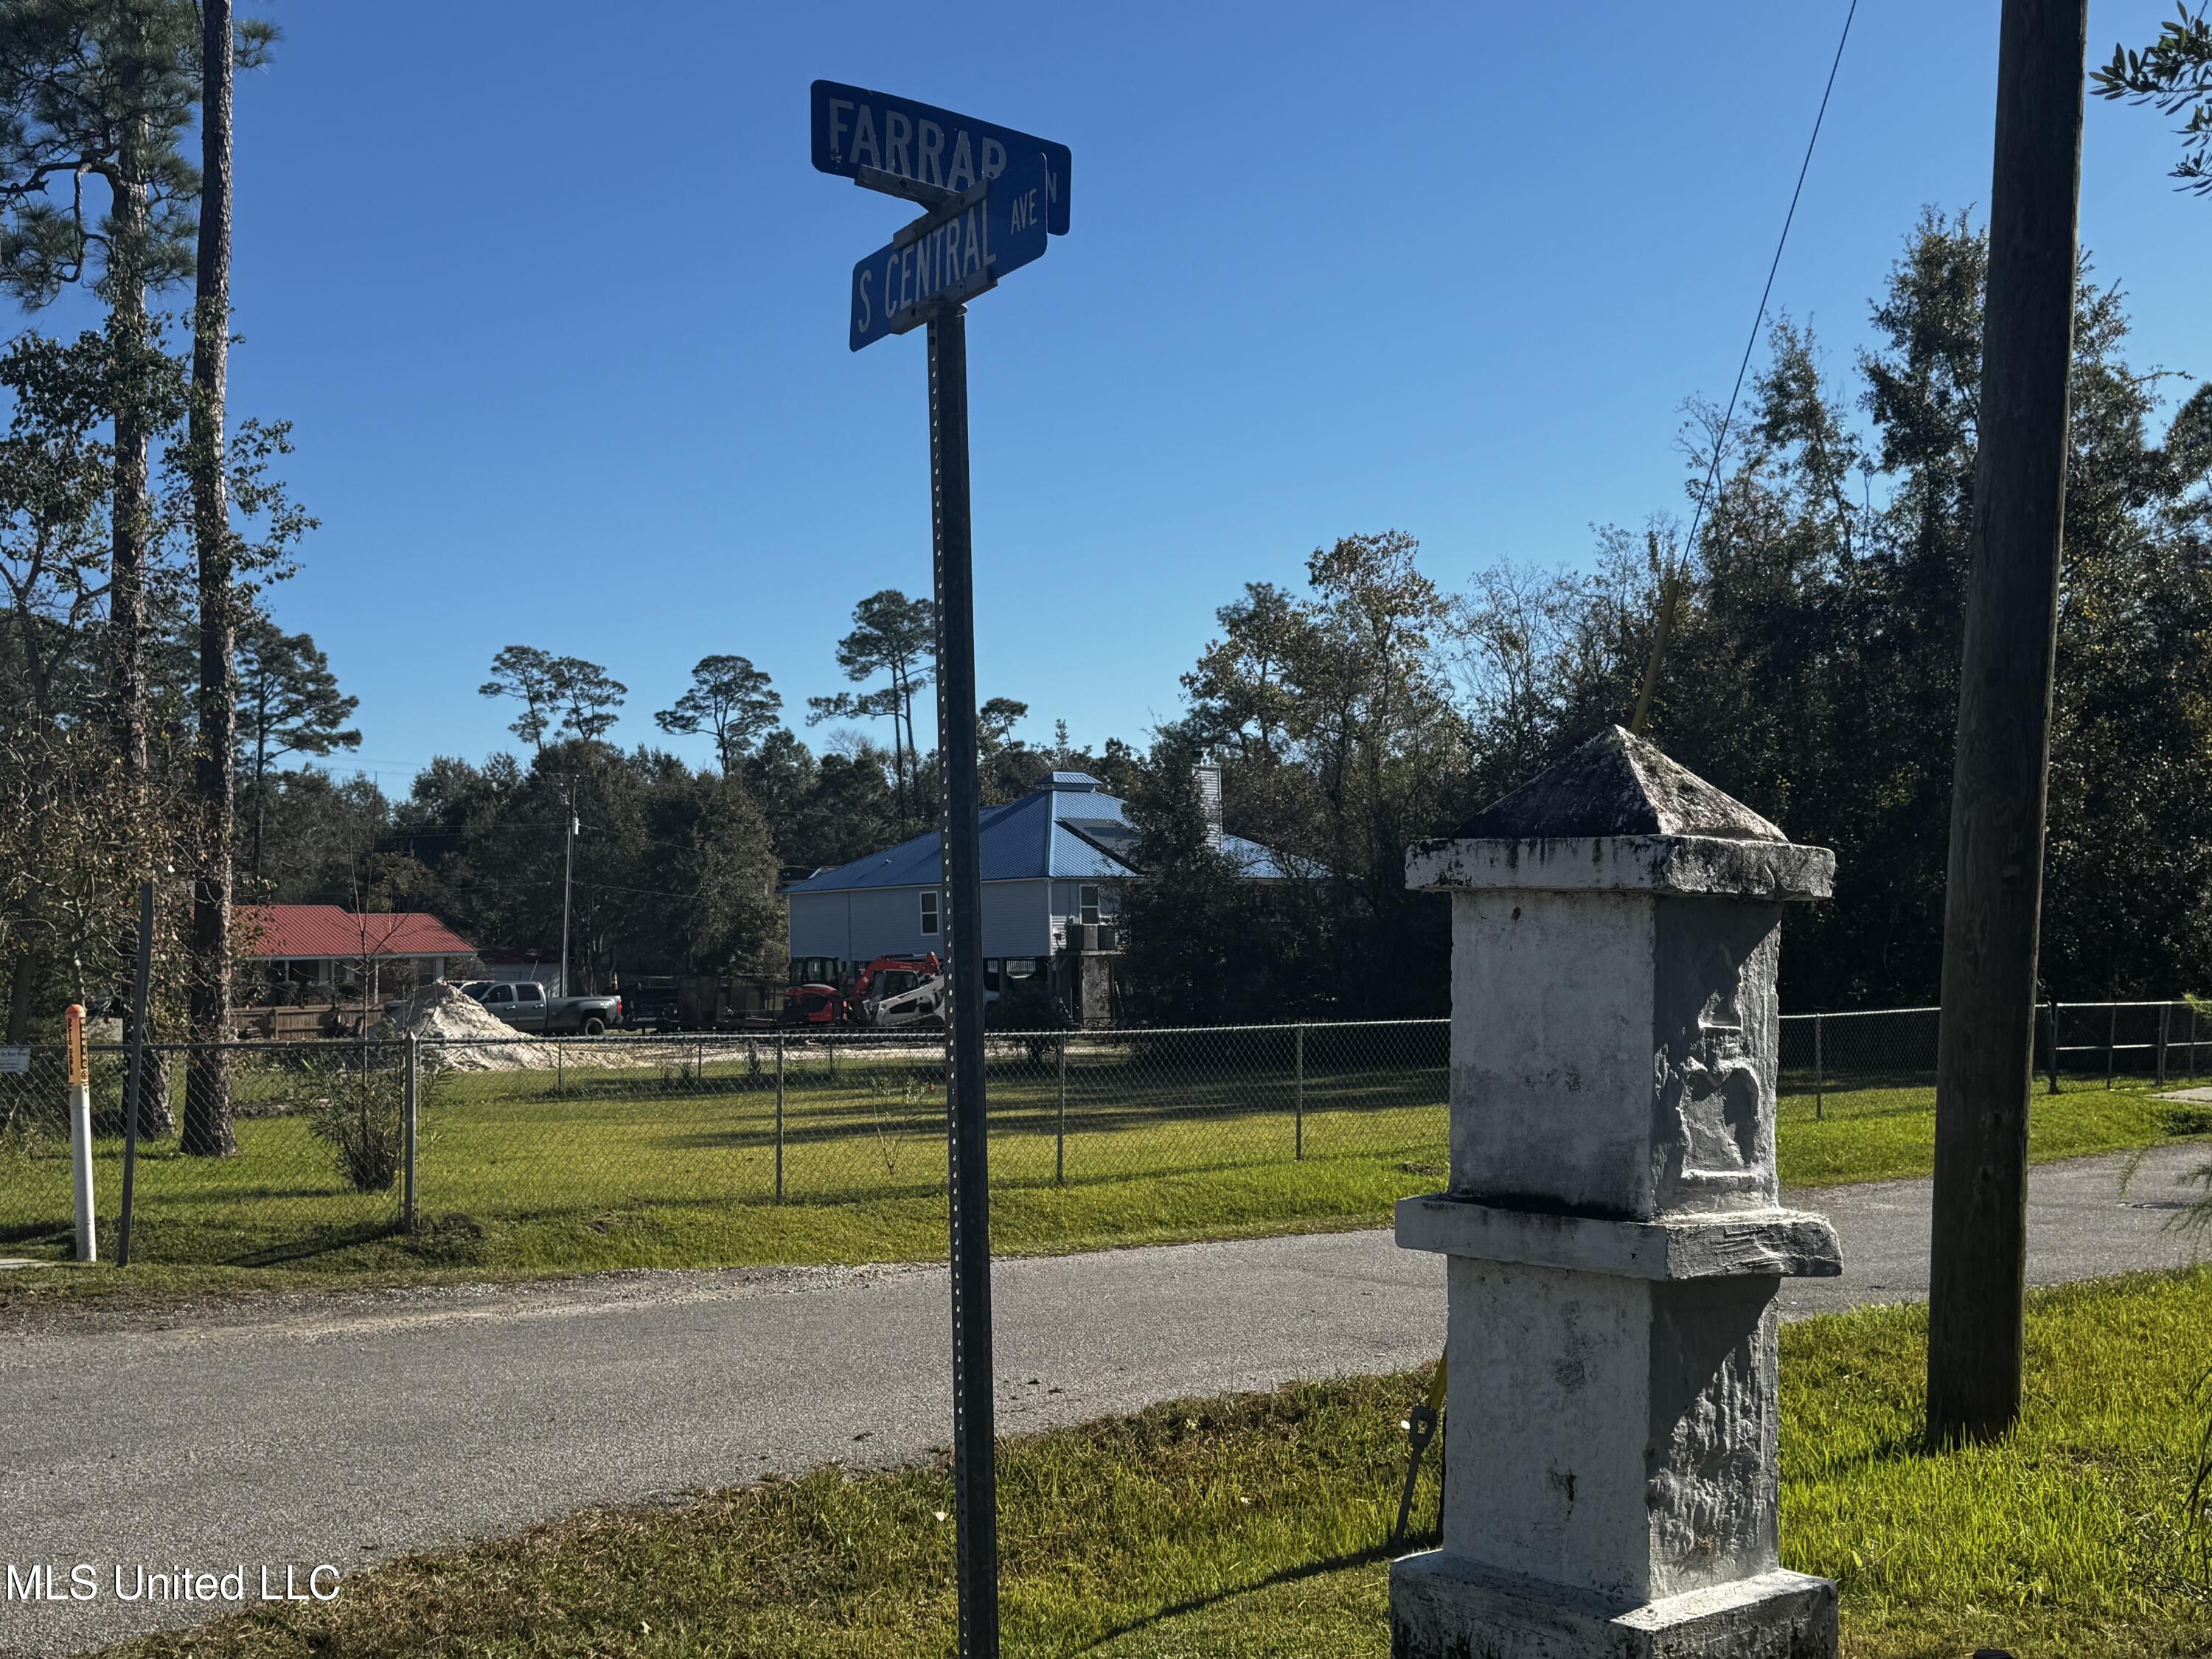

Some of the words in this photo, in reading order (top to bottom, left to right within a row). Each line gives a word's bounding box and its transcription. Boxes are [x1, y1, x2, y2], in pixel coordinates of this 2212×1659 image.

[858, 268, 872, 333] S
[885, 199, 997, 319] CENTRAL
[1010, 188, 1038, 235] AVE
